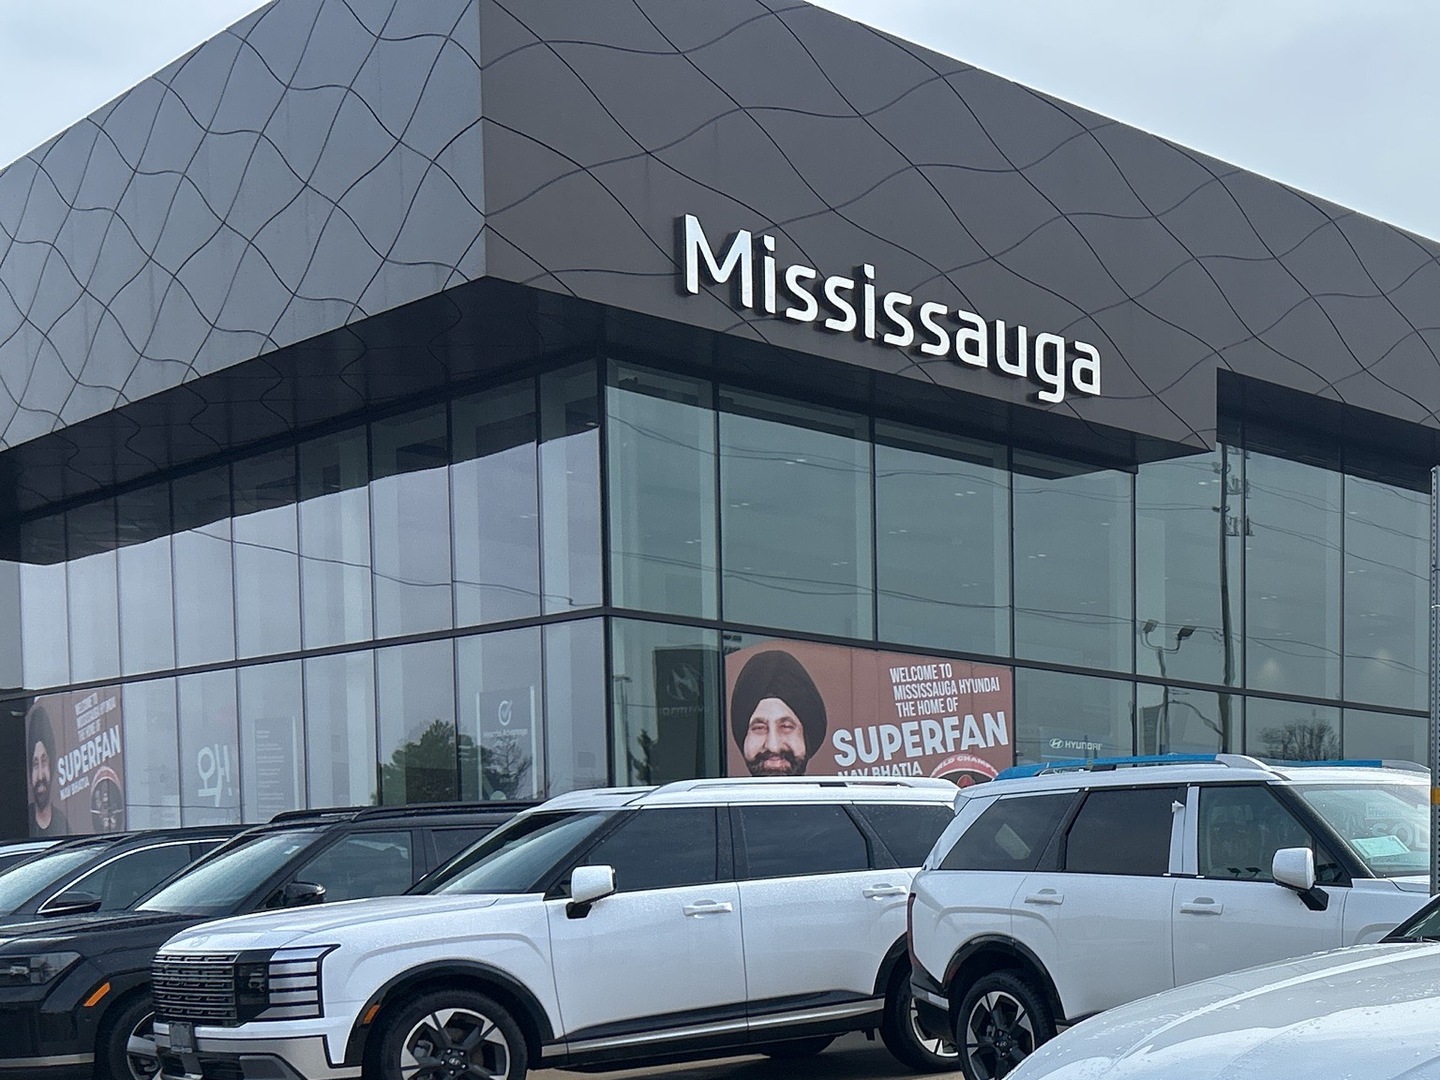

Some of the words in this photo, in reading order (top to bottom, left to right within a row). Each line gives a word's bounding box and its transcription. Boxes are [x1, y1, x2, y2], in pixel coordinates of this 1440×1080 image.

[683, 213, 1101, 404] Mississauga
[890, 665, 938, 683] WELCOME
[939, 663, 952, 678] TO
[893, 680, 958, 701] MISSISSAUGA
[958, 676, 1000, 695] HYUNDAI
[896, 702, 916, 718] THE
[917, 699, 945, 717] HOME
[947, 697, 959, 712] OF
[832, 711, 1009, 767] SUPERFAN
[57, 725, 121, 786] SUPERFAN
[871, 761, 923, 777] BHATIA
